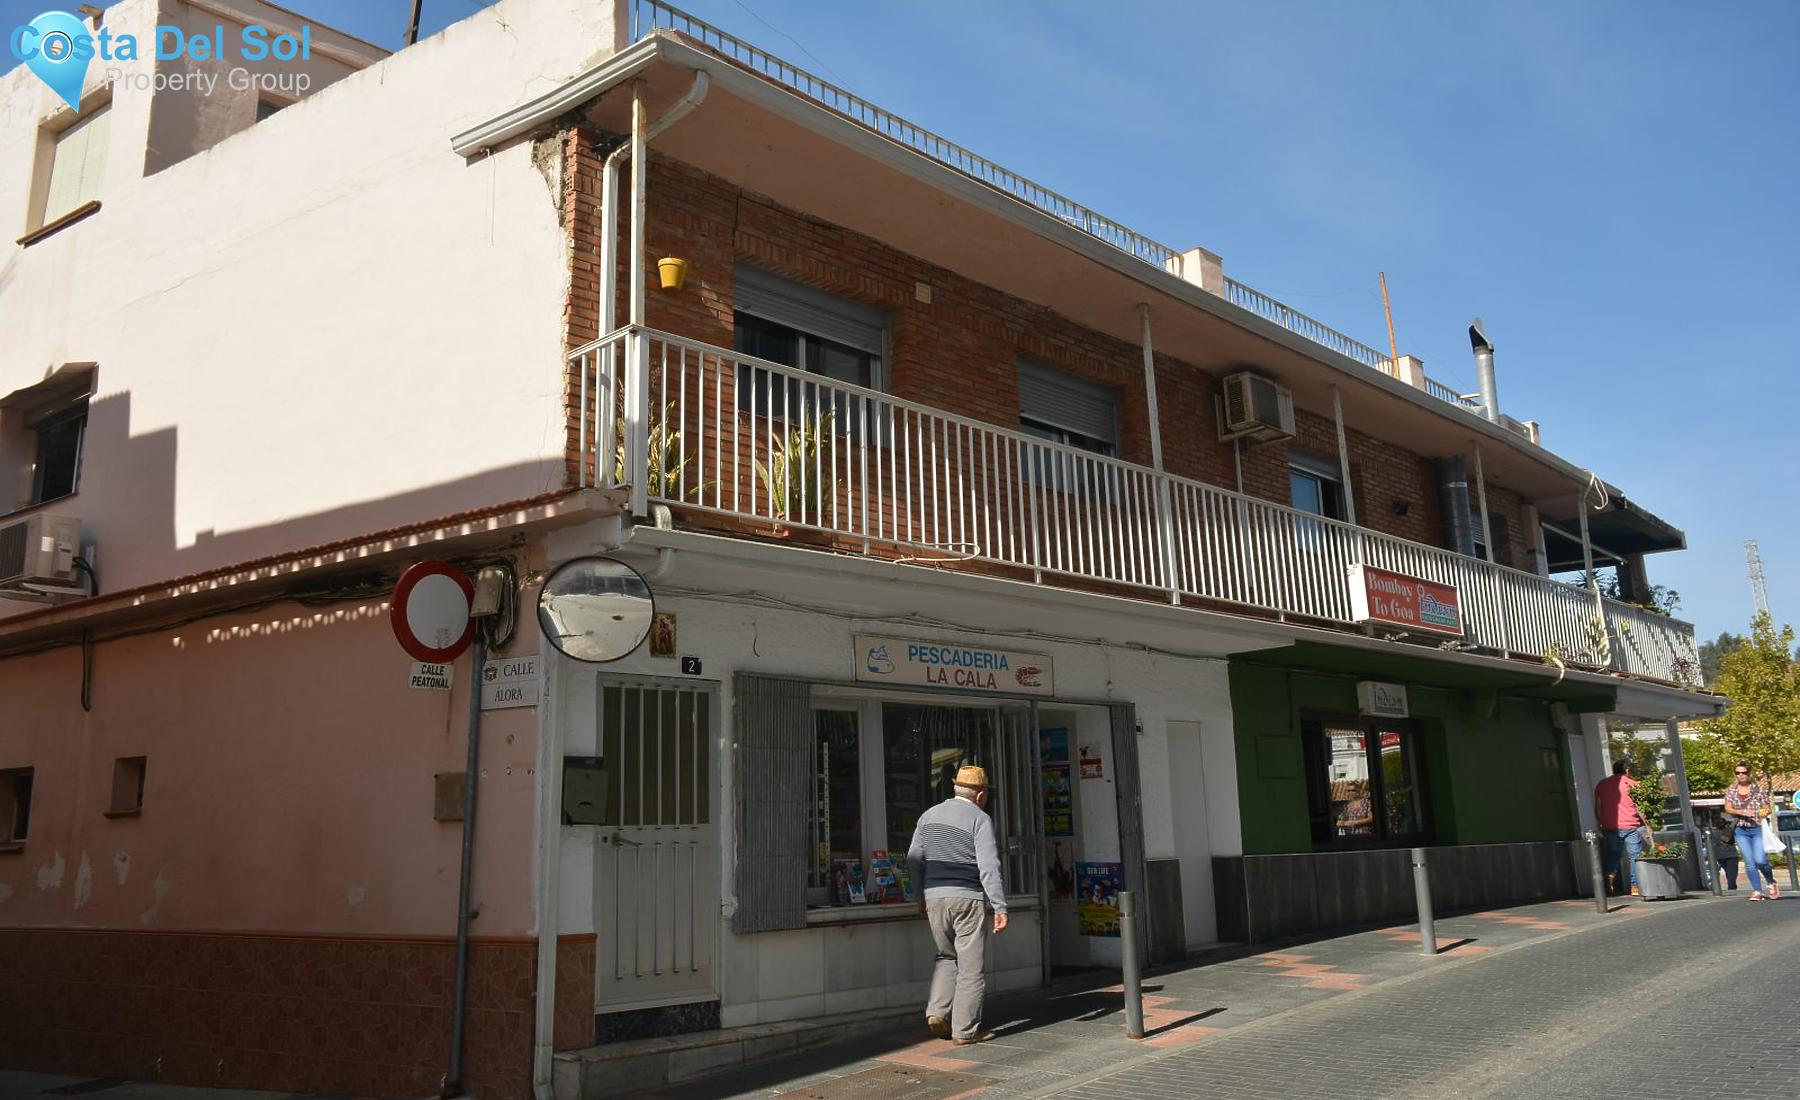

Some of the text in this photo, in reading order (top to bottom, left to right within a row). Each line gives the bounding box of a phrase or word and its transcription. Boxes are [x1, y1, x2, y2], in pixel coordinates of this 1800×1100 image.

[1368, 571, 1413, 598] Bombay
[1373, 596, 1388, 616] To
[1391, 597, 1414, 620] Goa
[908, 644, 1009, 671] PESCADERIA
[421, 664, 446, 676] CALLE
[503, 661, 535, 677] CALLE
[688, 660, 695, 673] 2
[411, 675, 450, 689] PEATONAL
[926, 666, 998, 690] LA CALA
[494, 687, 523, 702] ÁLORA
